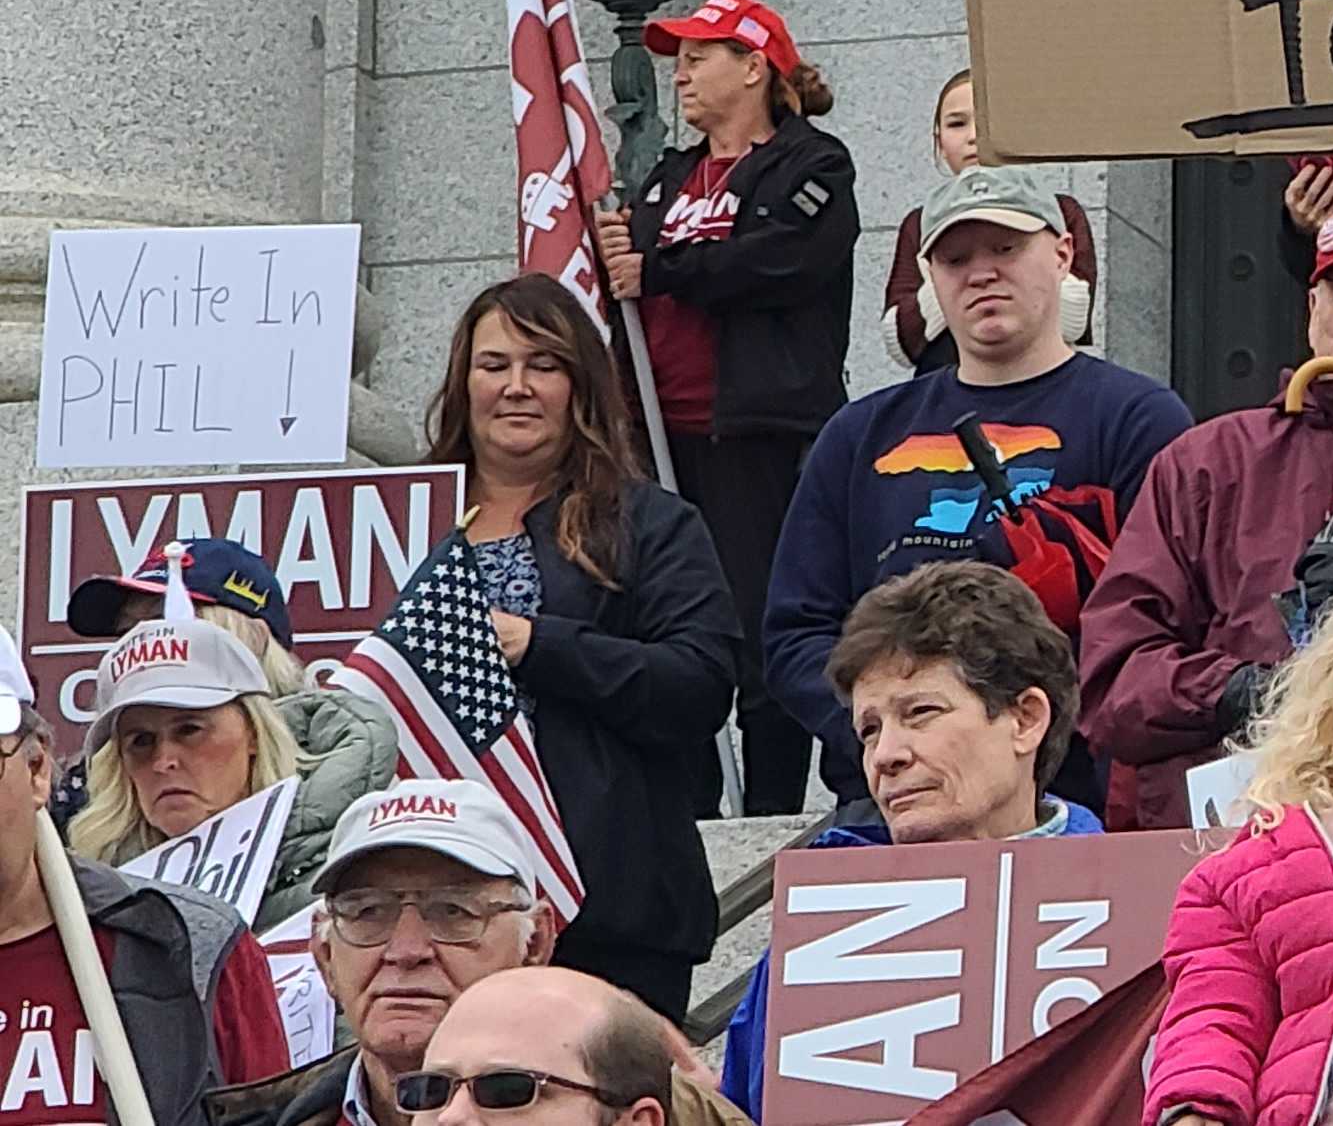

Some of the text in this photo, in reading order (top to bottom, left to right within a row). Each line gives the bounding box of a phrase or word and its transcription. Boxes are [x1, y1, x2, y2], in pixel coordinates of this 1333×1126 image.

[61, 240, 323, 341] Write In
[59, 354, 232, 448] PHIL
[369, 794, 457, 827] LYMAN
